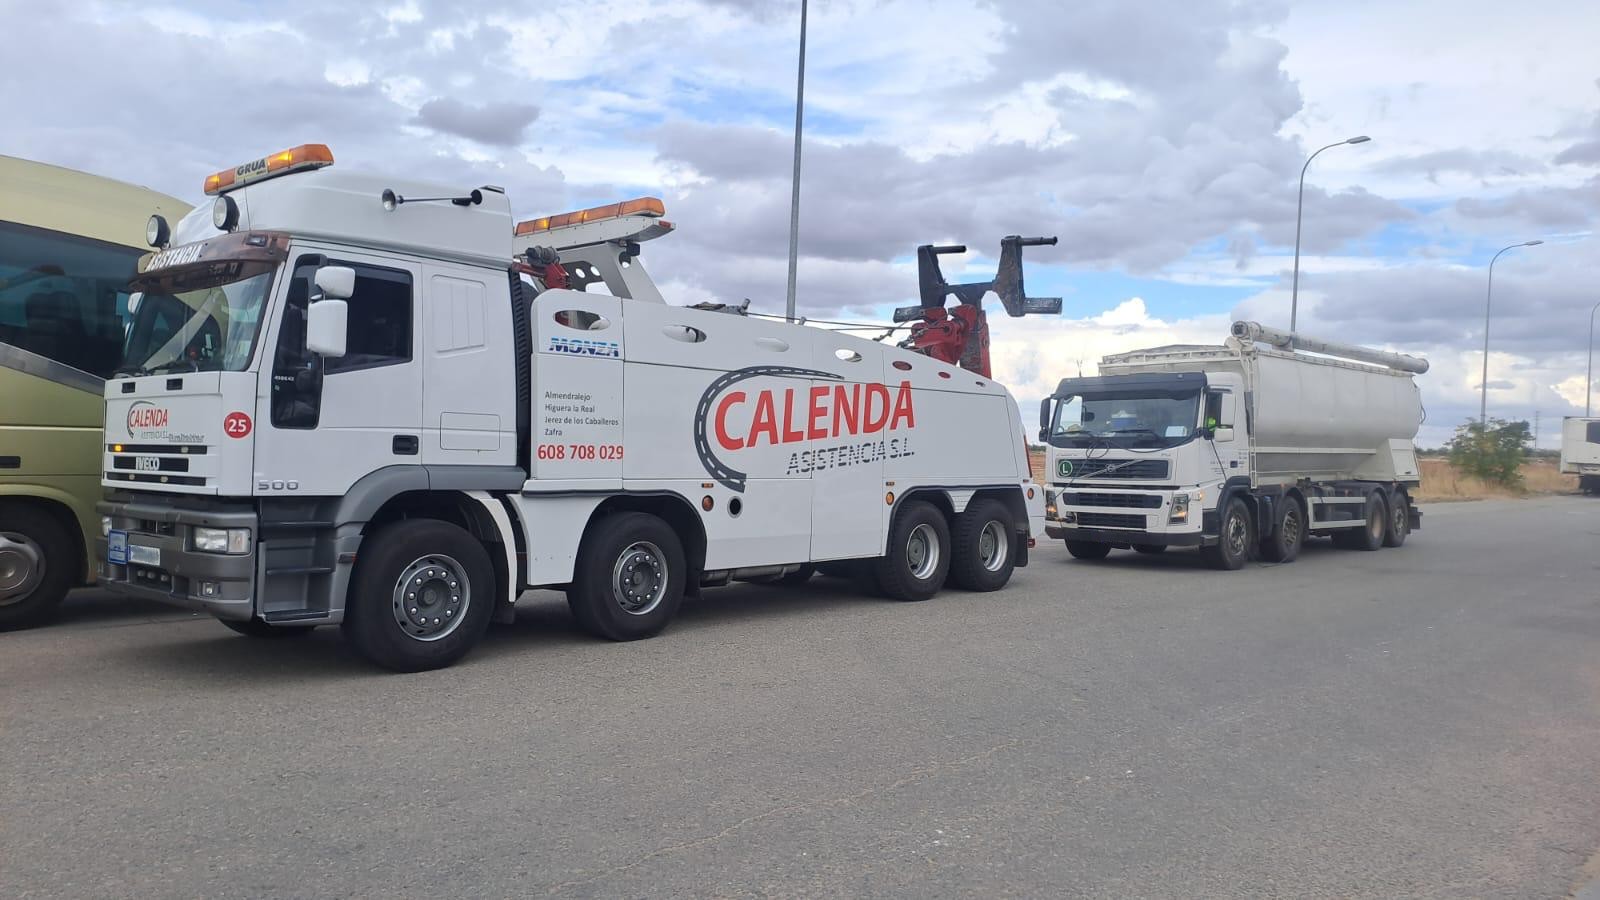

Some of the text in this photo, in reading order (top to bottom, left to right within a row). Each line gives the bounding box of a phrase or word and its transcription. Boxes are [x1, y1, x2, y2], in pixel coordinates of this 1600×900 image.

[237, 159, 266, 176] GRUA
[144, 244, 203, 272] ASISTENCIA
[549, 337, 619, 357] MONZA
[545, 392, 591, 402] Almendralejo
[545, 404, 571, 413] Higuera
[581, 405, 595, 413] Real
[714, 380, 915, 451] CALENDA
[129, 409, 168, 427] CALENDA
[585, 417, 619, 426] Caballeros
[228, 419, 247, 433] 25
[544, 428, 562, 436] Zafra
[538, 445, 624, 460] 608 708 029
[786, 440, 886, 475] ASISTENCIA
[136, 457, 160, 470] IVECO
[258, 480, 299, 491] 500
